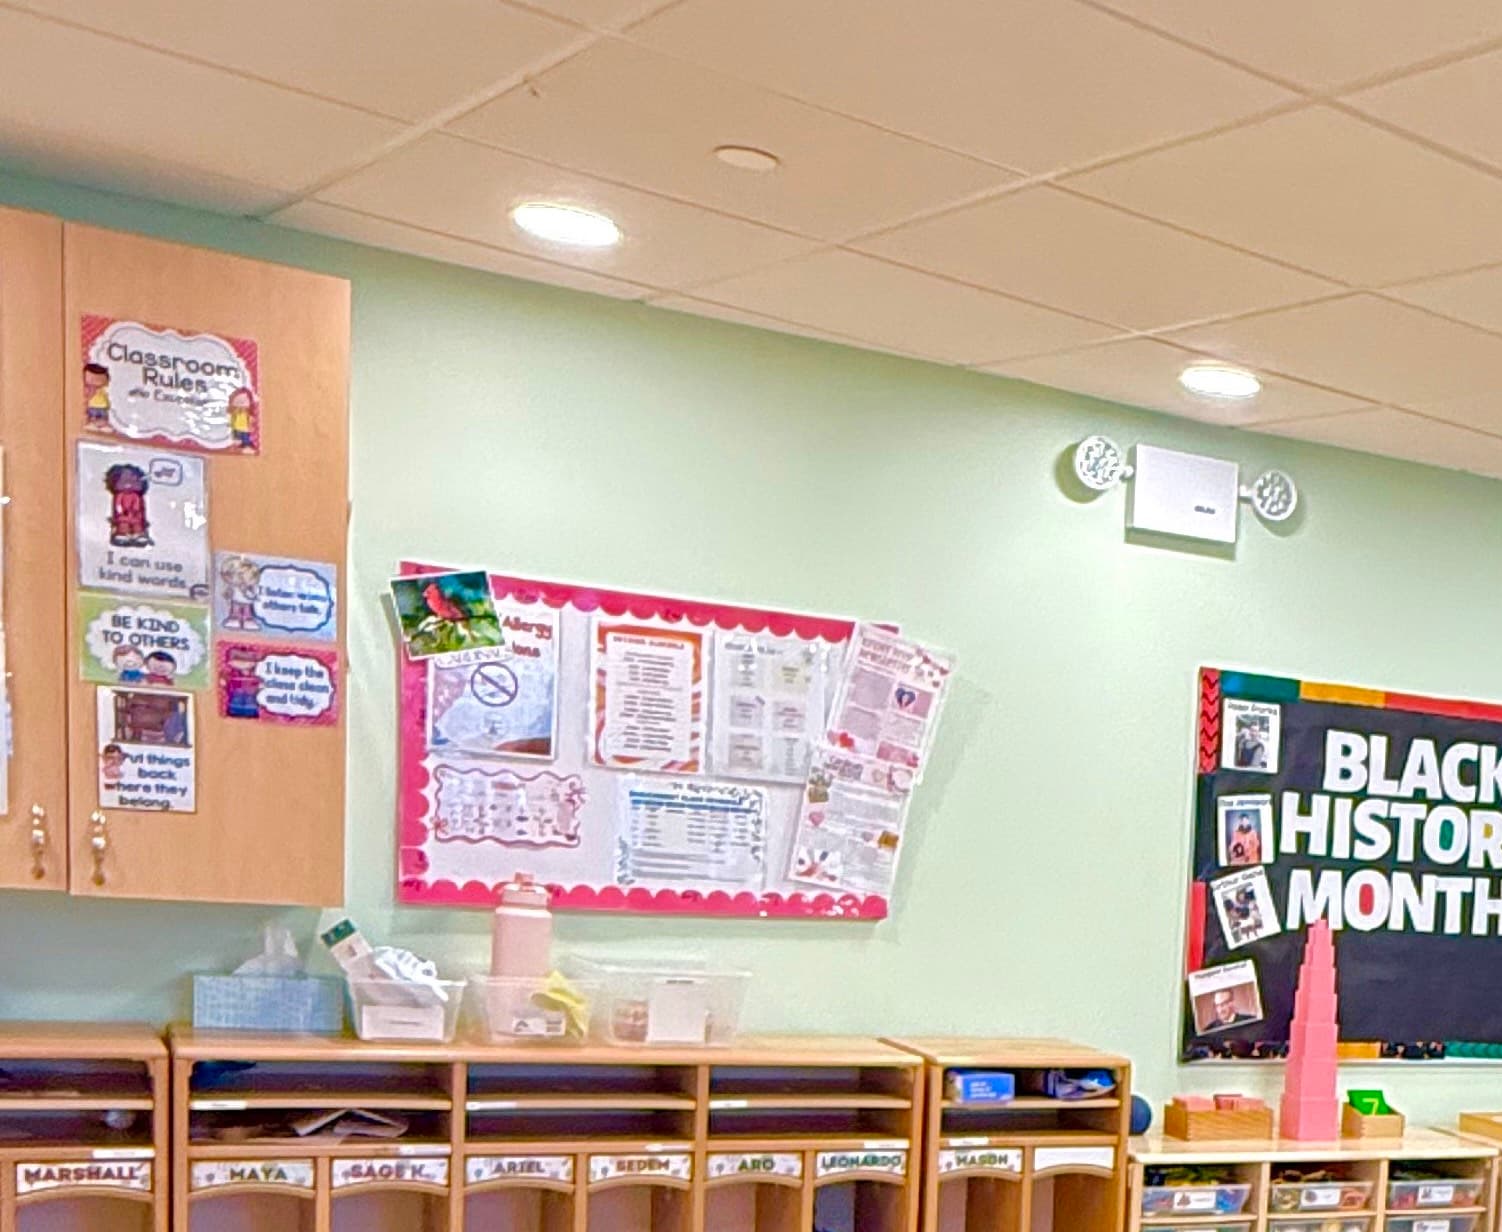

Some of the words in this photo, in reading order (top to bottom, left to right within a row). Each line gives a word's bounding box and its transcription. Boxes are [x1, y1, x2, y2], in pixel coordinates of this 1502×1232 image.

[107, 343, 240, 376] Classroom
[143, 367, 208, 392] Rules
[107, 551, 114, 565] I
[119, 556, 150, 569] can
[155, 561, 183, 573] use
[98, 567, 132, 583] kind
[112, 614, 132, 630] BE
[137, 618, 180, 634] KIND
[102, 630, 124, 645] TO
[128, 633, 190, 651] OTHERS
[265, 662, 272, 675] I
[274, 662, 302, 679] keep
[304, 665, 324, 678] the
[266, 693, 288, 704] and
[146, 753, 190, 768] things
[137, 767, 176, 781] back
[104, 782, 152, 793] where
[154, 784, 188, 797] they
[738, 1157, 776, 1171] ARO
[822, 1155, 902, 1169] LEONARDO
[956, 1153, 1009, 1166] MASON
[24, 1166, 140, 1183] MARSHALL
[229, 1167, 288, 1181] MAYA
[351, 1164, 406, 1178] SAGE
[491, 1161, 545, 1175] ARIEL
